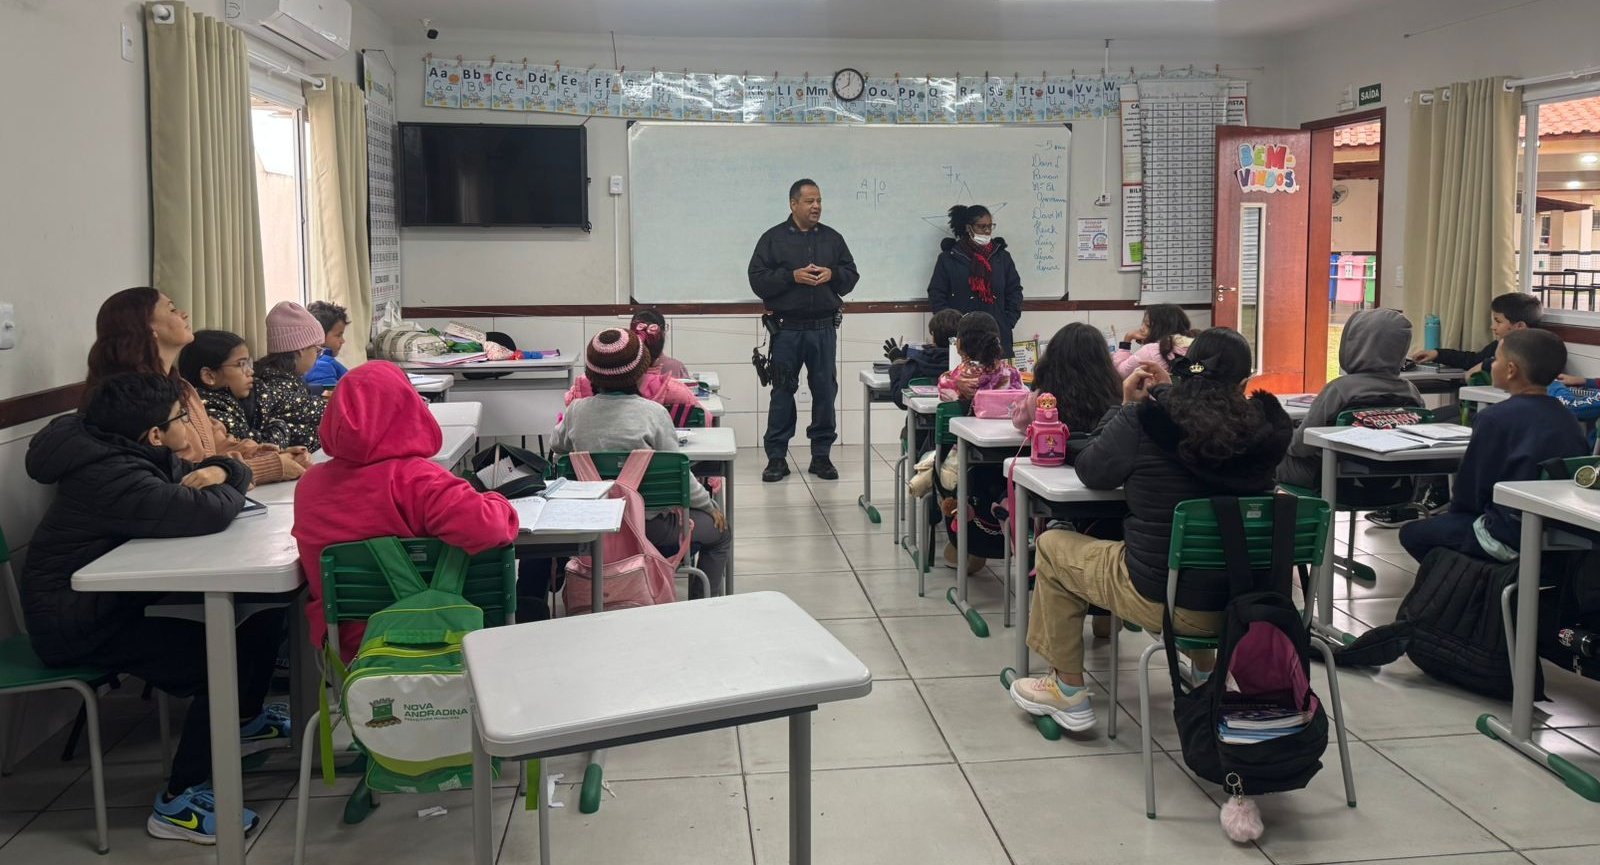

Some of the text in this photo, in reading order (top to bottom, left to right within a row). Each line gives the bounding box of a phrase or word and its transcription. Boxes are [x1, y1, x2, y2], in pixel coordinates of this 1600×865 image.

[806, 86, 828, 96] Mm
[403, 703, 433, 711] NOVA
[404, 708, 468, 717] ANDRADINA
